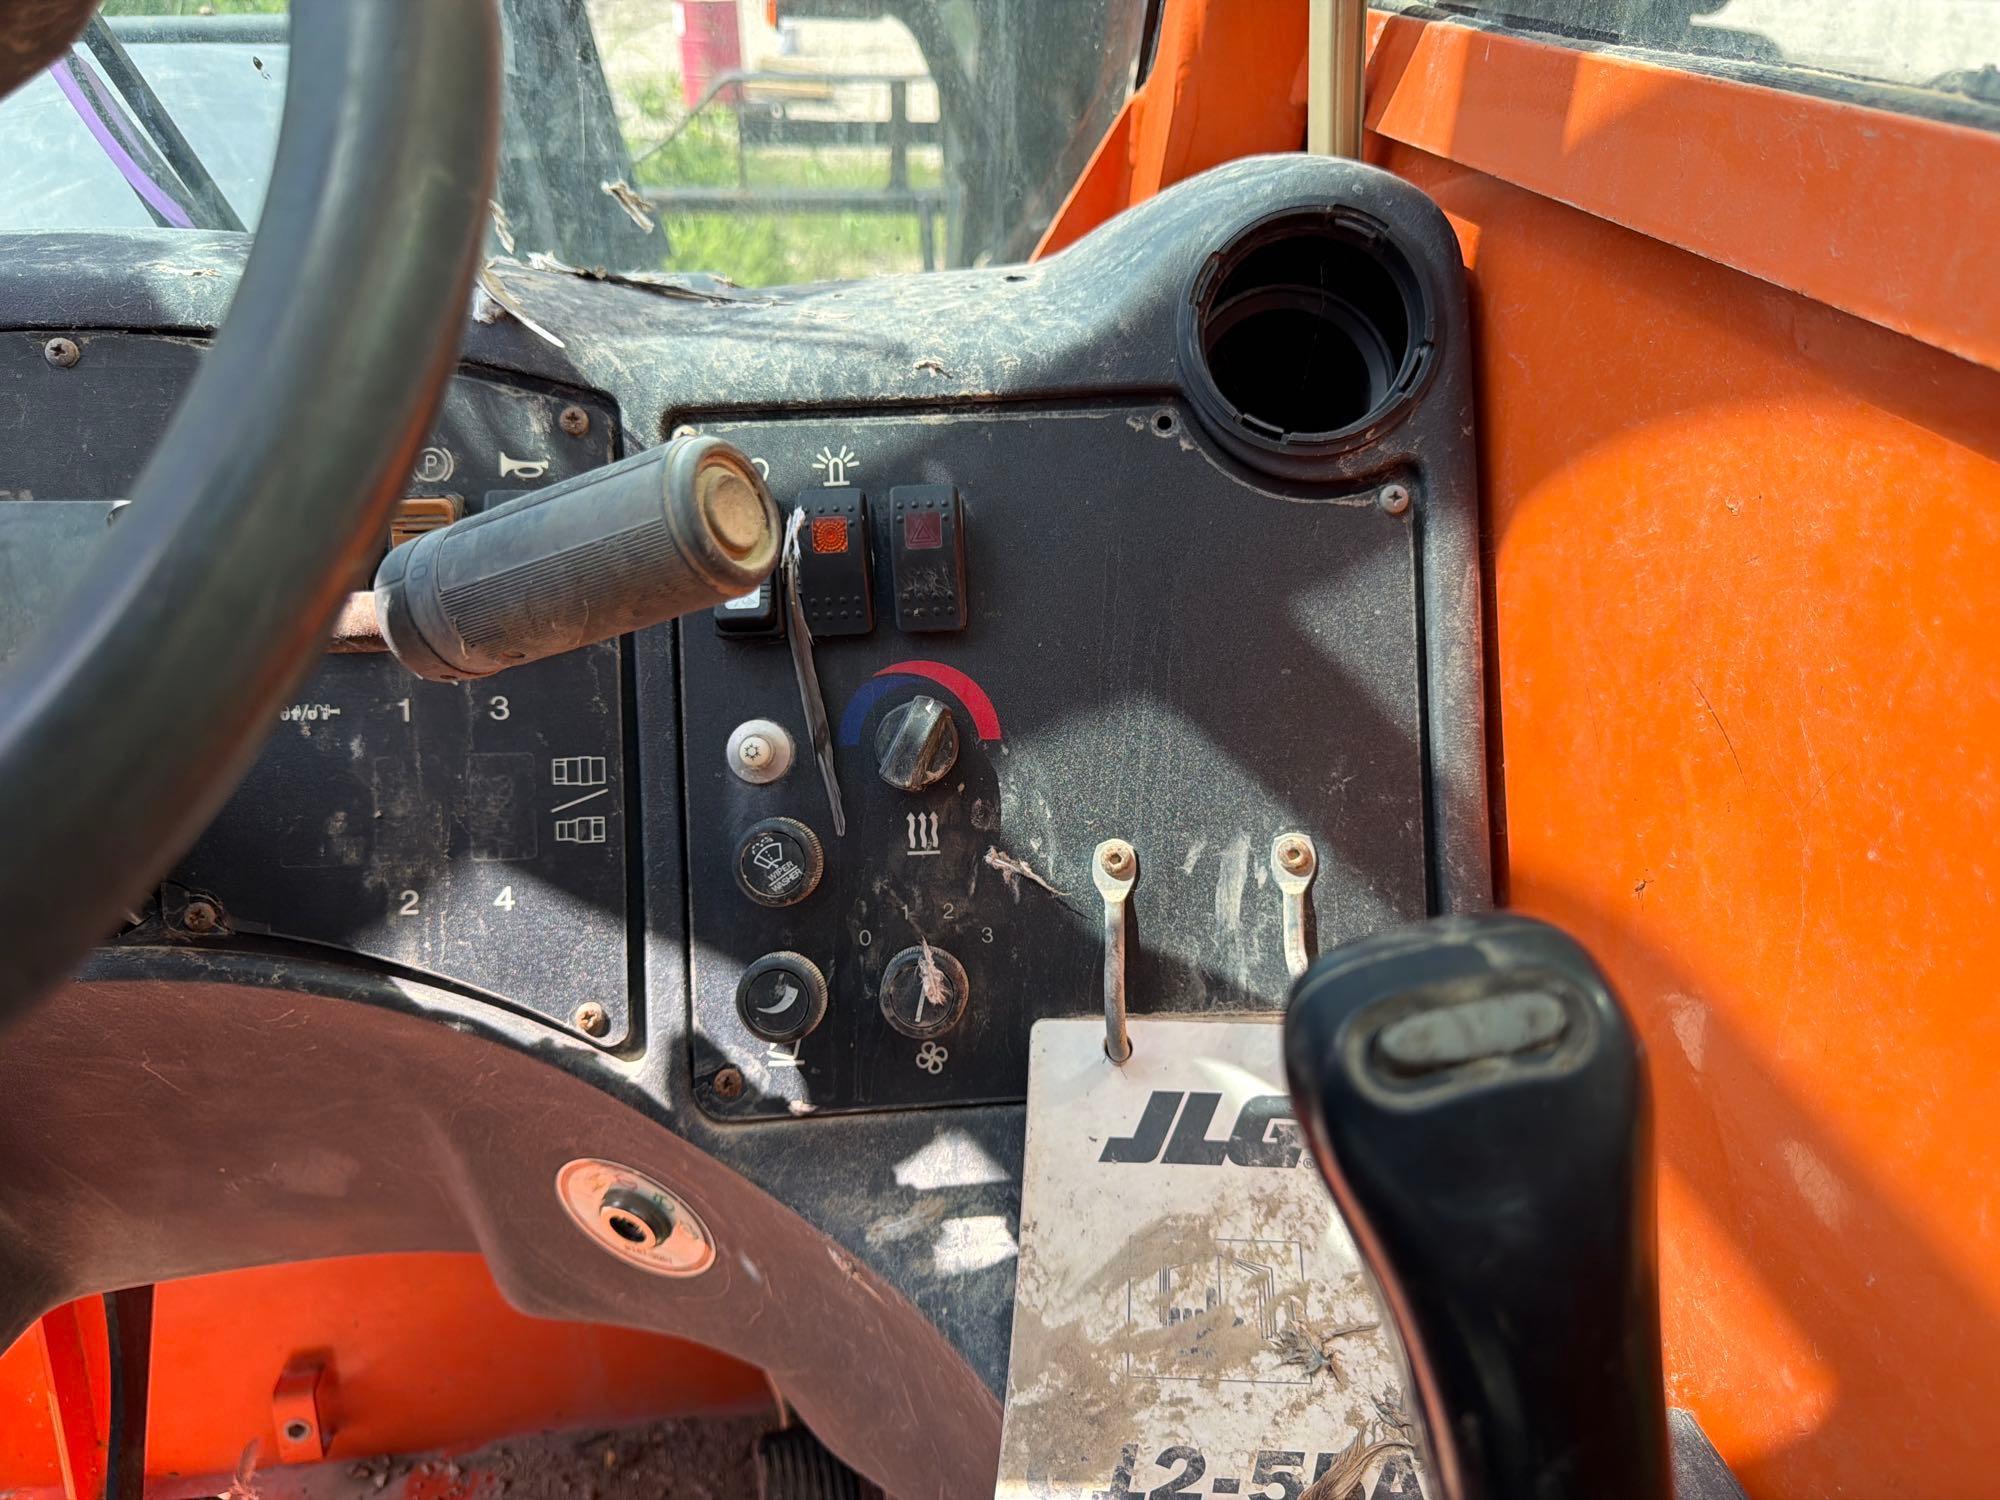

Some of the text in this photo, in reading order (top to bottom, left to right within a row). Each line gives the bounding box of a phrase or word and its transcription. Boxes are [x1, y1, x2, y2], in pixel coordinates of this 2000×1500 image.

[425, 454, 439, 475] P
[398, 699, 411, 722] 1
[489, 697, 511, 720] 3
[767, 860, 794, 881] WIPER
[771, 868, 803, 892] WASHER
[400, 890, 419, 914] 2
[494, 887, 516, 910] 4
[901, 904, 909, 919] 1
[943, 903, 954, 918] 2
[859, 931, 872, 946] 0
[982, 927, 994, 943] 3
[1098, 1091, 1306, 1168] JLG
